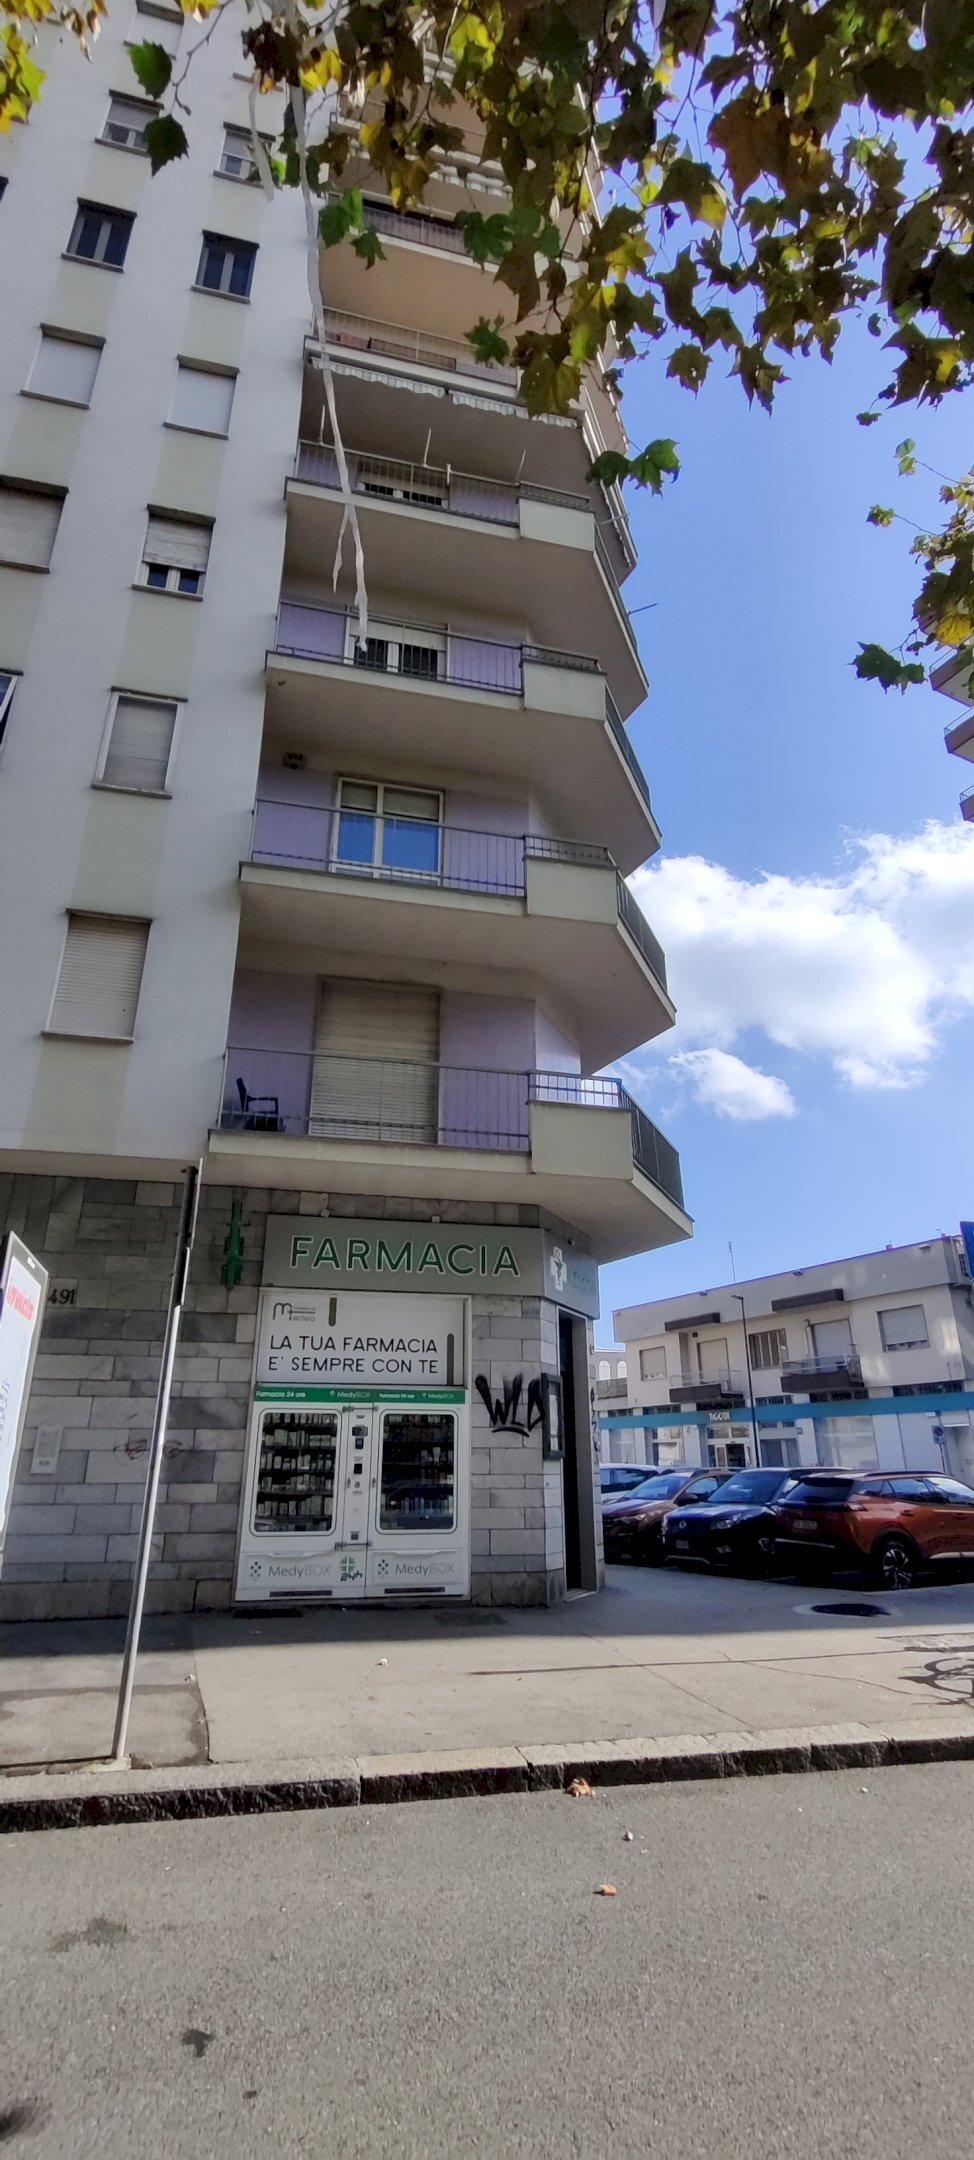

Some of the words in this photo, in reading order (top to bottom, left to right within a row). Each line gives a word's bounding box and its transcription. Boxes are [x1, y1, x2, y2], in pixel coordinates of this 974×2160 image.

[288, 1234, 521, 1278] FARMACIA
[47, 1287, 76, 1305] 491
[270, 1335, 292, 1350] LA
[299, 1335, 336, 1351] TUA
[343, 1336, 438, 1354] FARMACIA
[291, 1356, 366, 1373] SEMPRE
[372, 1358, 412, 1374] CON
[419, 1359, 439, 1374] TE
[256, 1390, 285, 1398] Farmacia
[268, 1563, 331, 1579] MedyBOX
[340, 1571, 363, 1582] 24h
[395, 1562, 455, 1577] MedyBOX
